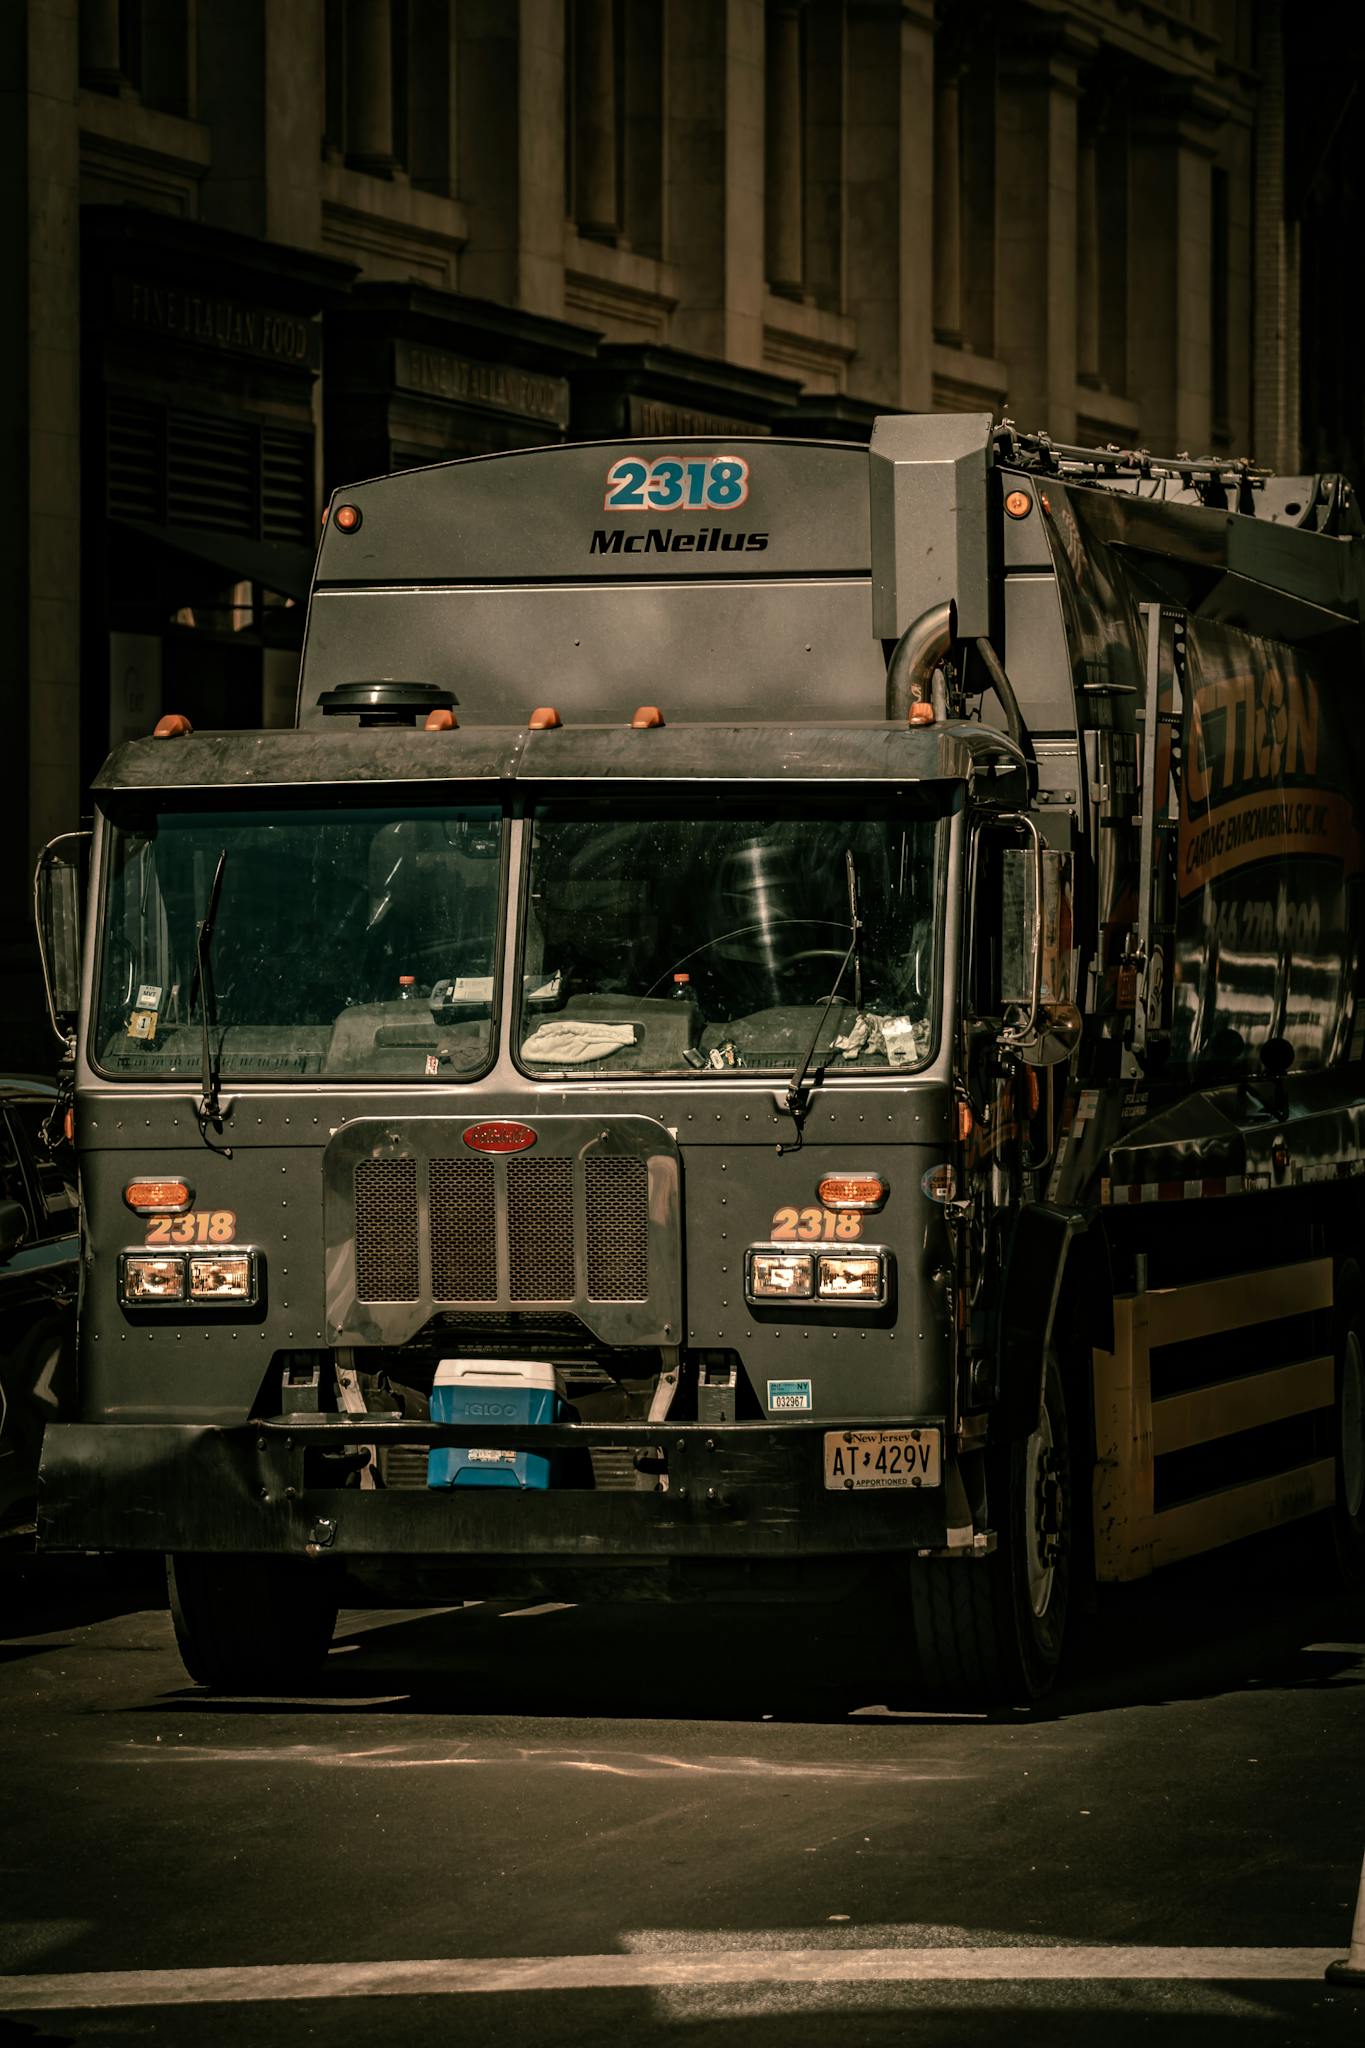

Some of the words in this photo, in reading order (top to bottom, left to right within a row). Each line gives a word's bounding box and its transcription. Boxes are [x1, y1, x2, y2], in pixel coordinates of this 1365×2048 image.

[130, 282, 176, 328] FINE
[184, 295, 256, 345] ITALIAN
[263, 316, 308, 359] FOOD
[606, 457, 748, 509] 2318
[590, 527, 769, 554] McNeilus
[146, 1210, 236, 1243] 2318
[770, 1205, 863, 1241] 2318
[797, 1382, 808, 1390] NY
[464, 1403, 517, 1417] IGLOO
[776, 1396, 804, 1407] 032967
[853, 1433, 877, 1443] New
[878, 1432, 911, 1445] Jersey
[833, 1446, 859, 1476] AT
[875, 1444, 931, 1474] 429V
[856, 1478, 908, 1486] APPORTIONED
